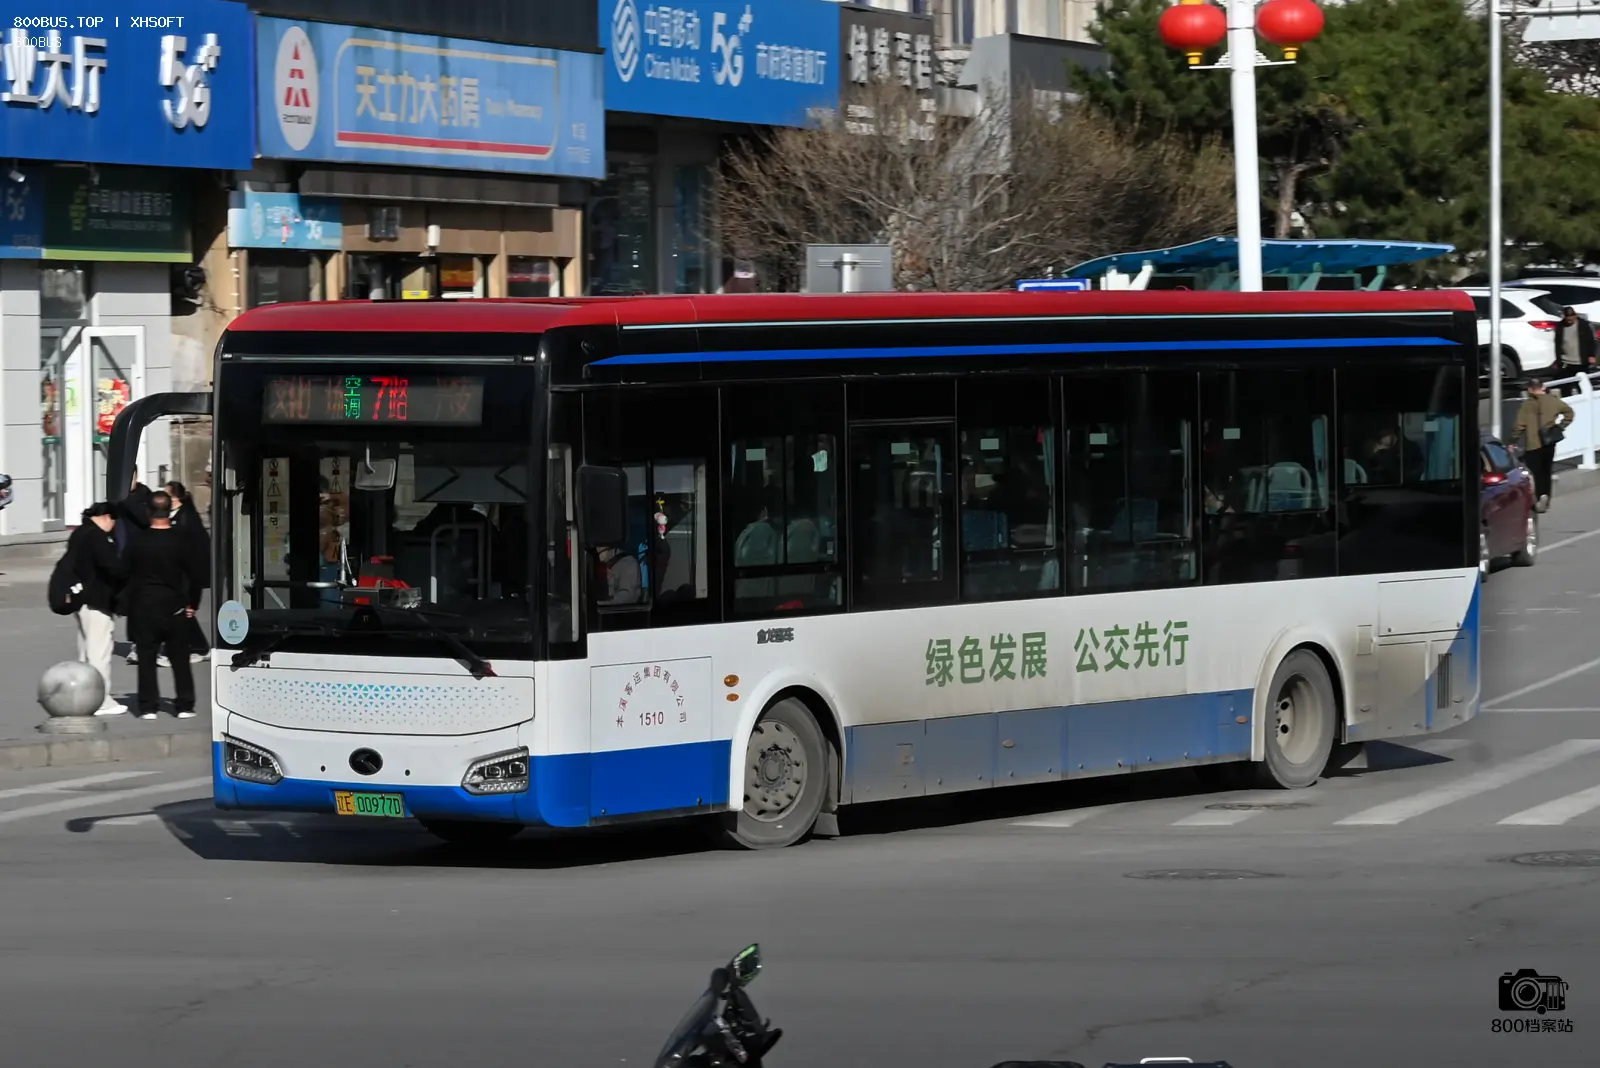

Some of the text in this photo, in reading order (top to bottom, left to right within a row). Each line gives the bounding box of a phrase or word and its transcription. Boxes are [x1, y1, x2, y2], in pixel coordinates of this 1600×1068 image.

[644, 4, 700, 50] 中国移动
[644, 53, 700, 83] China Mobile
[356, 64, 480, 128] 天士力大药房
[344, 375, 361, 420] 空调
[370, 376, 408, 420] 7路
[925, 620, 1189, 687] 绿色发展 公交先行
[616, 665, 686, 727] 本溪客运集团有限公司
[639, 711, 664, 726] 1510
